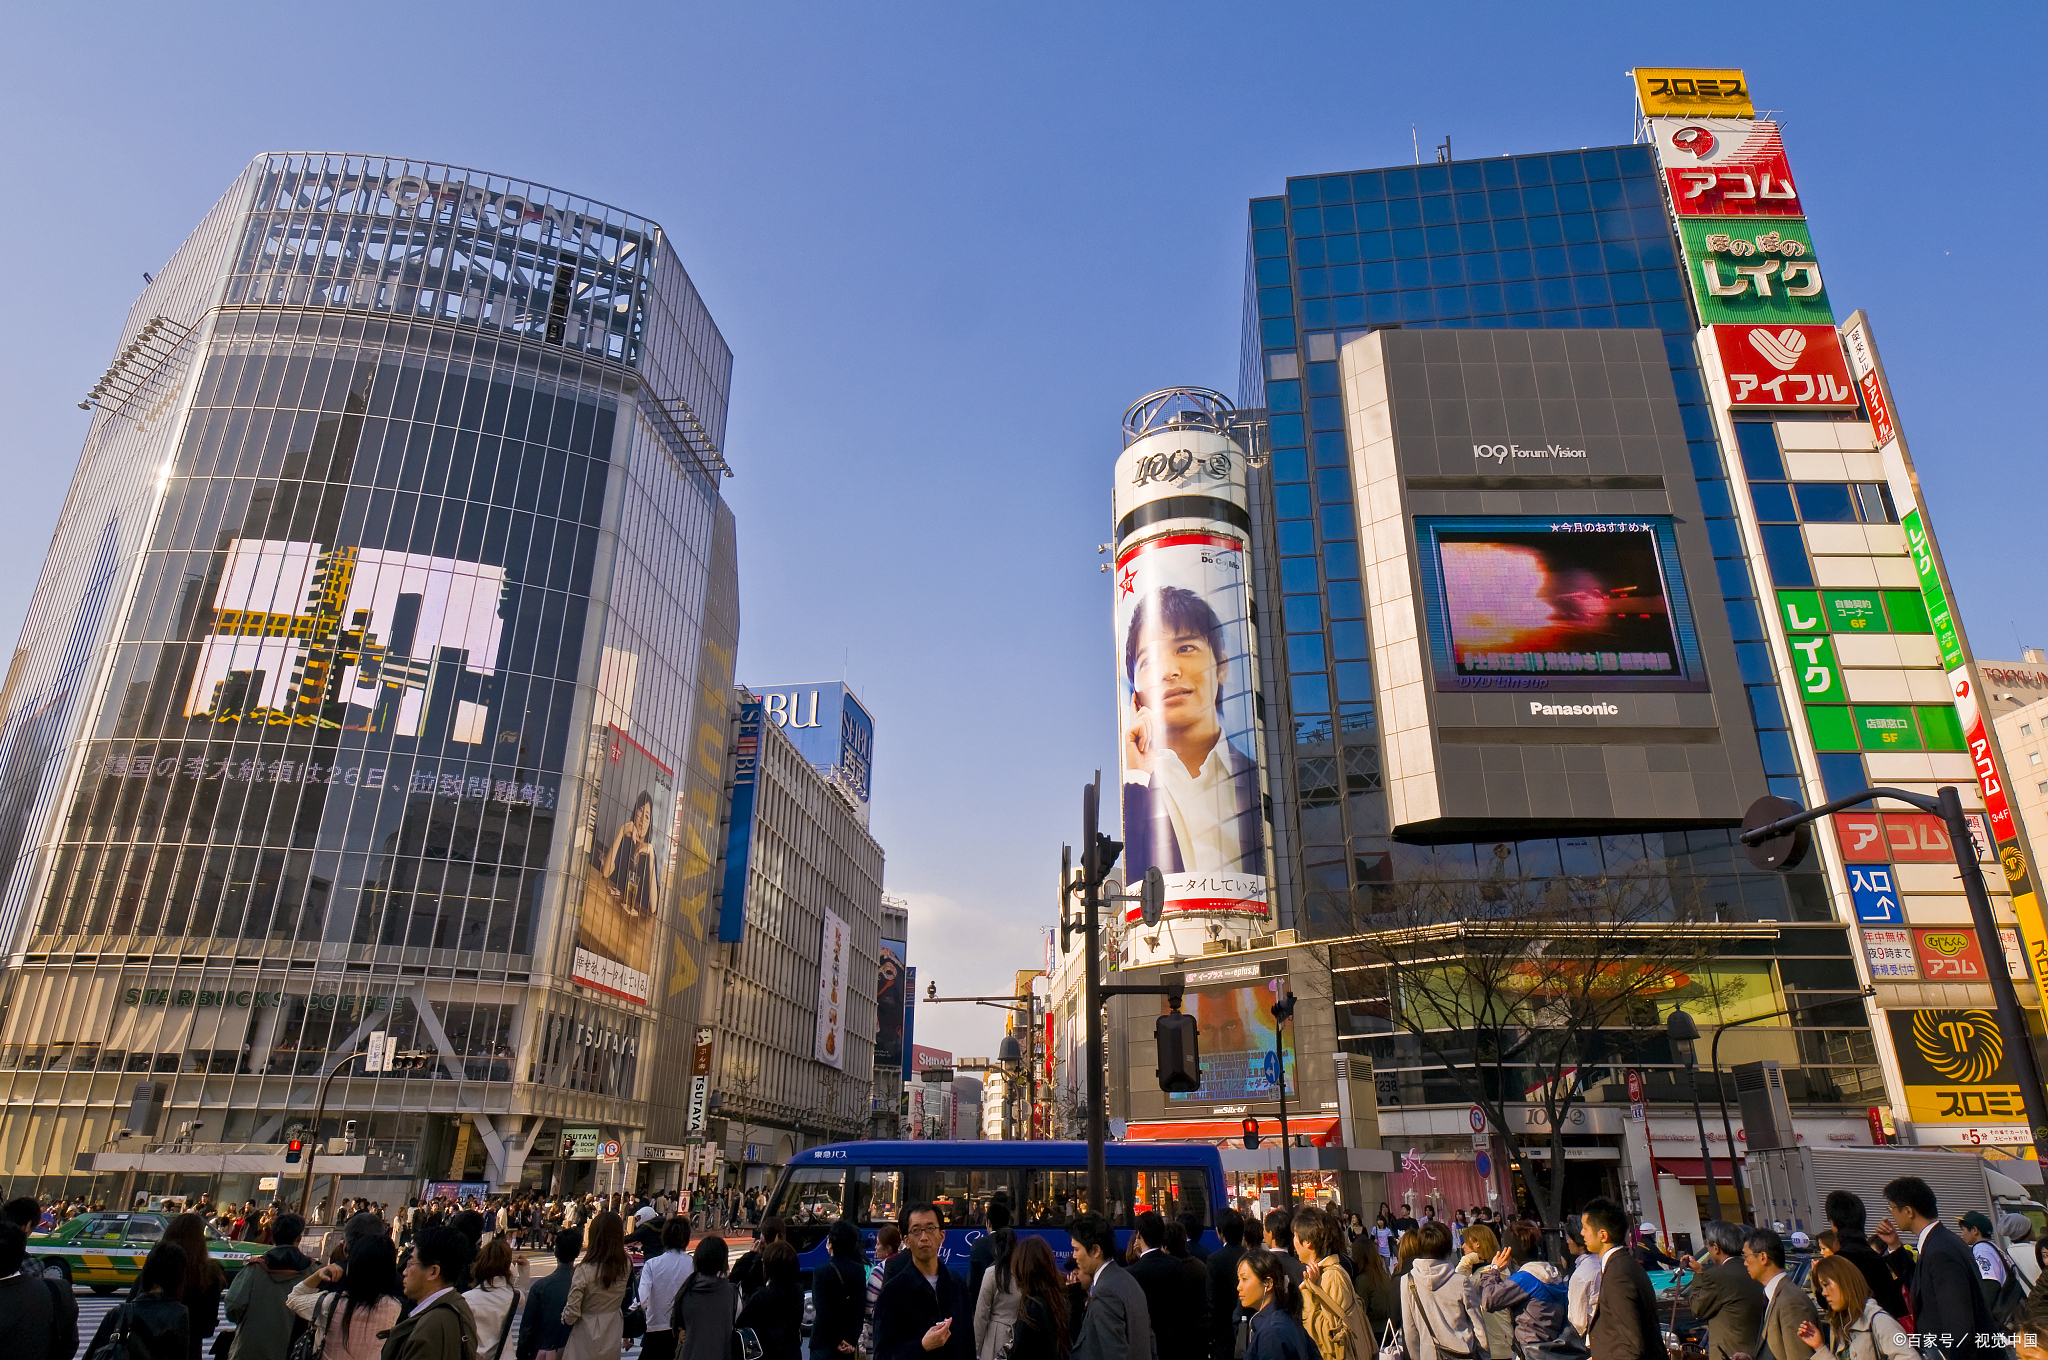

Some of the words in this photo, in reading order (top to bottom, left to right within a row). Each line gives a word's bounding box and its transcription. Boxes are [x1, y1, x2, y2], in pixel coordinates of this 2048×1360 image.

[1646, 77, 1747, 98] プロミス
[1680, 171, 1797, 200] アコム
[1702, 259, 1823, 297] レイク
[1729, 373, 1849, 403] アイフル
[1867, 384, 1890, 439] アイフル
[1473, 444, 1509, 465] 109
[1510, 445, 1548, 459] Forum
[1547, 444, 1587, 459] Vision
[1909, 528, 1931, 576] レイク
[1837, 608, 1874, 617] コーナー
[1850, 619, 1867, 628] 6F
[1786, 603, 1831, 693] レイク
[1458, 676, 1493, 689] DVD
[1496, 676, 1550, 690] Lineup
[754, 690, 822, 728] BU
[1530, 702, 1619, 716] Panasonic
[734, 709, 760, 786] SEIBU
[842, 709, 871, 765] SEIBU
[1881, 732, 1898, 743] 5F
[1971, 738, 2001, 797] アコム
[1848, 823, 1949, 851] アコム
[1164, 877, 1263, 896] ータイしている。
[1851, 869, 1892, 893] 入口
[1864, 931, 1907, 942] 年中無休
[1928, 935, 1966, 947] むじんくん
[1868, 947, 1913, 959] 夜9時まで
[1871, 964, 1916, 976] 新規受付中
[1927, 958, 1978, 975] アコム
[124, 987, 289, 1008] STARBUCKS
[303, 992, 406, 1013] COFFEE
[576, 1023, 635, 1057] TSUTAYA
[691, 1075, 705, 1131] TSUTAYA
[1961, 1129, 1988, 1145] 約5分
[814, 1150, 848, 1159] 東急バス
